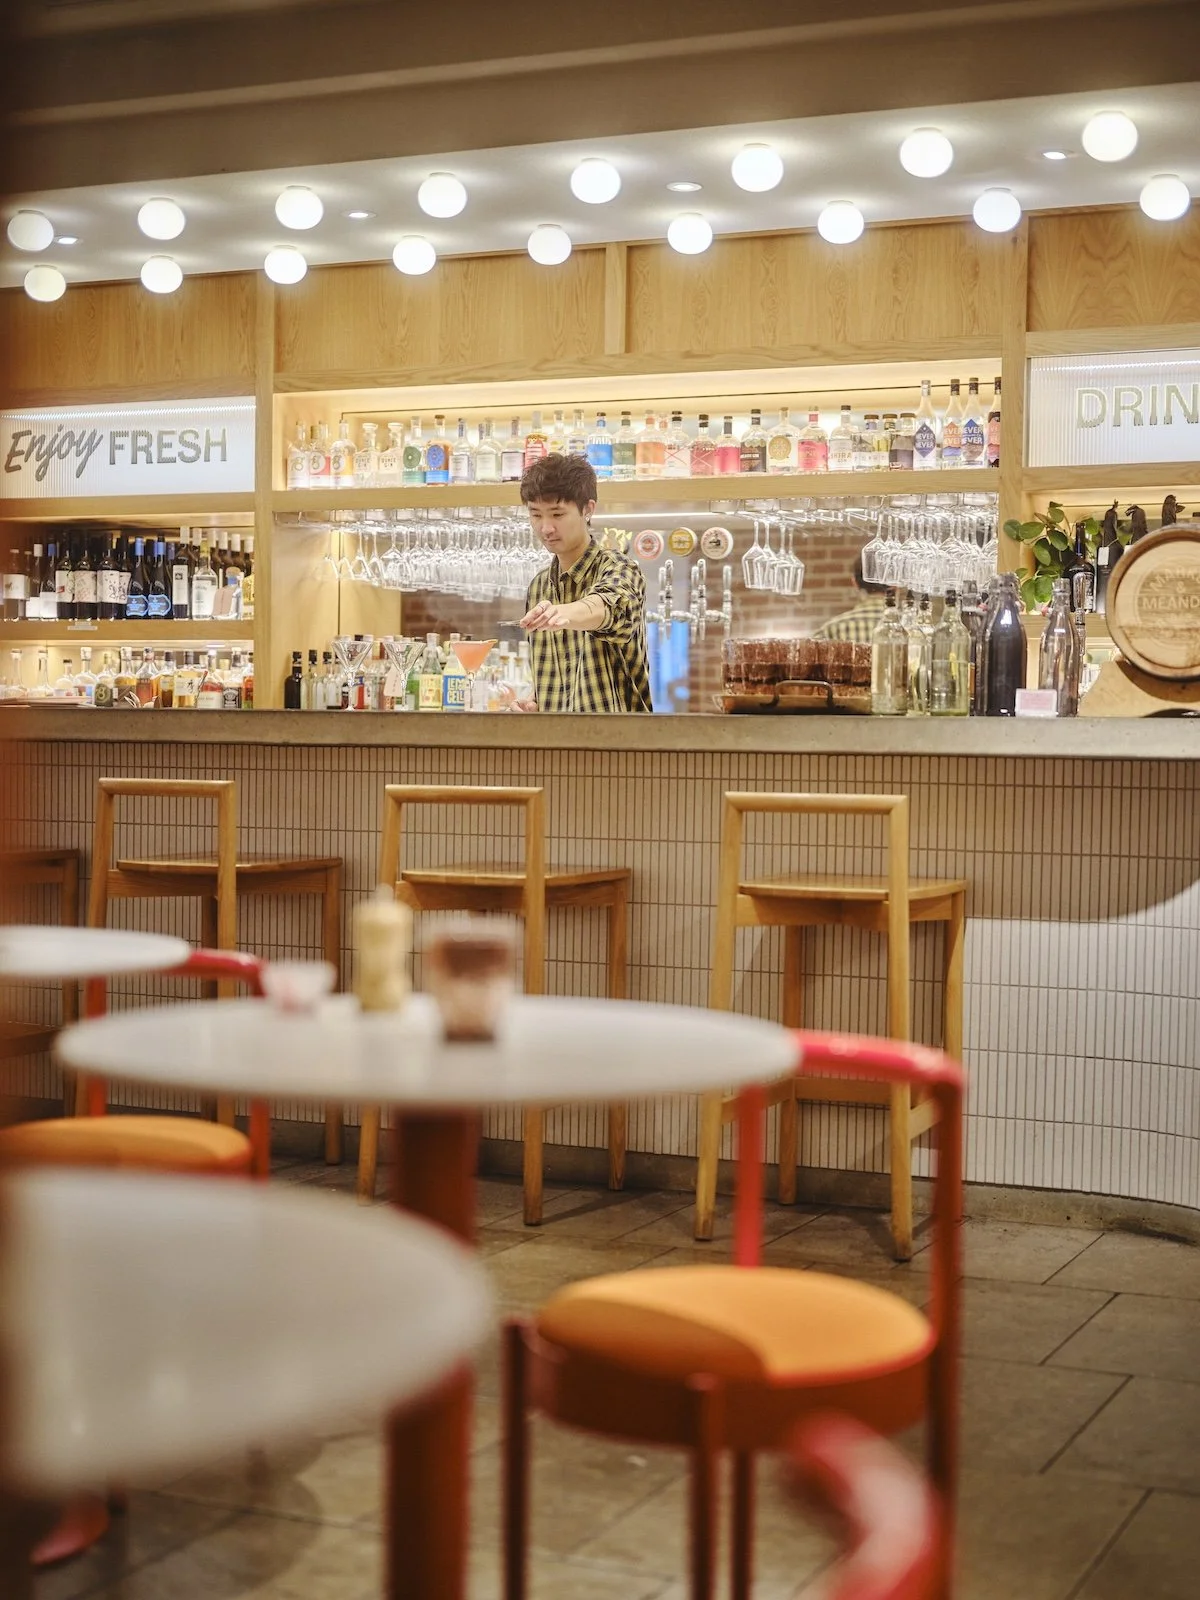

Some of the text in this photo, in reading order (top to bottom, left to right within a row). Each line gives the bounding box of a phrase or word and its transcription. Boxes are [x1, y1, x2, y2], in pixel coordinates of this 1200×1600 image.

[1076, 384, 1200, 429] DRIN
[3, 424, 228, 482] Enjoy FRESH
[1142, 595, 1200, 610] MEAND
